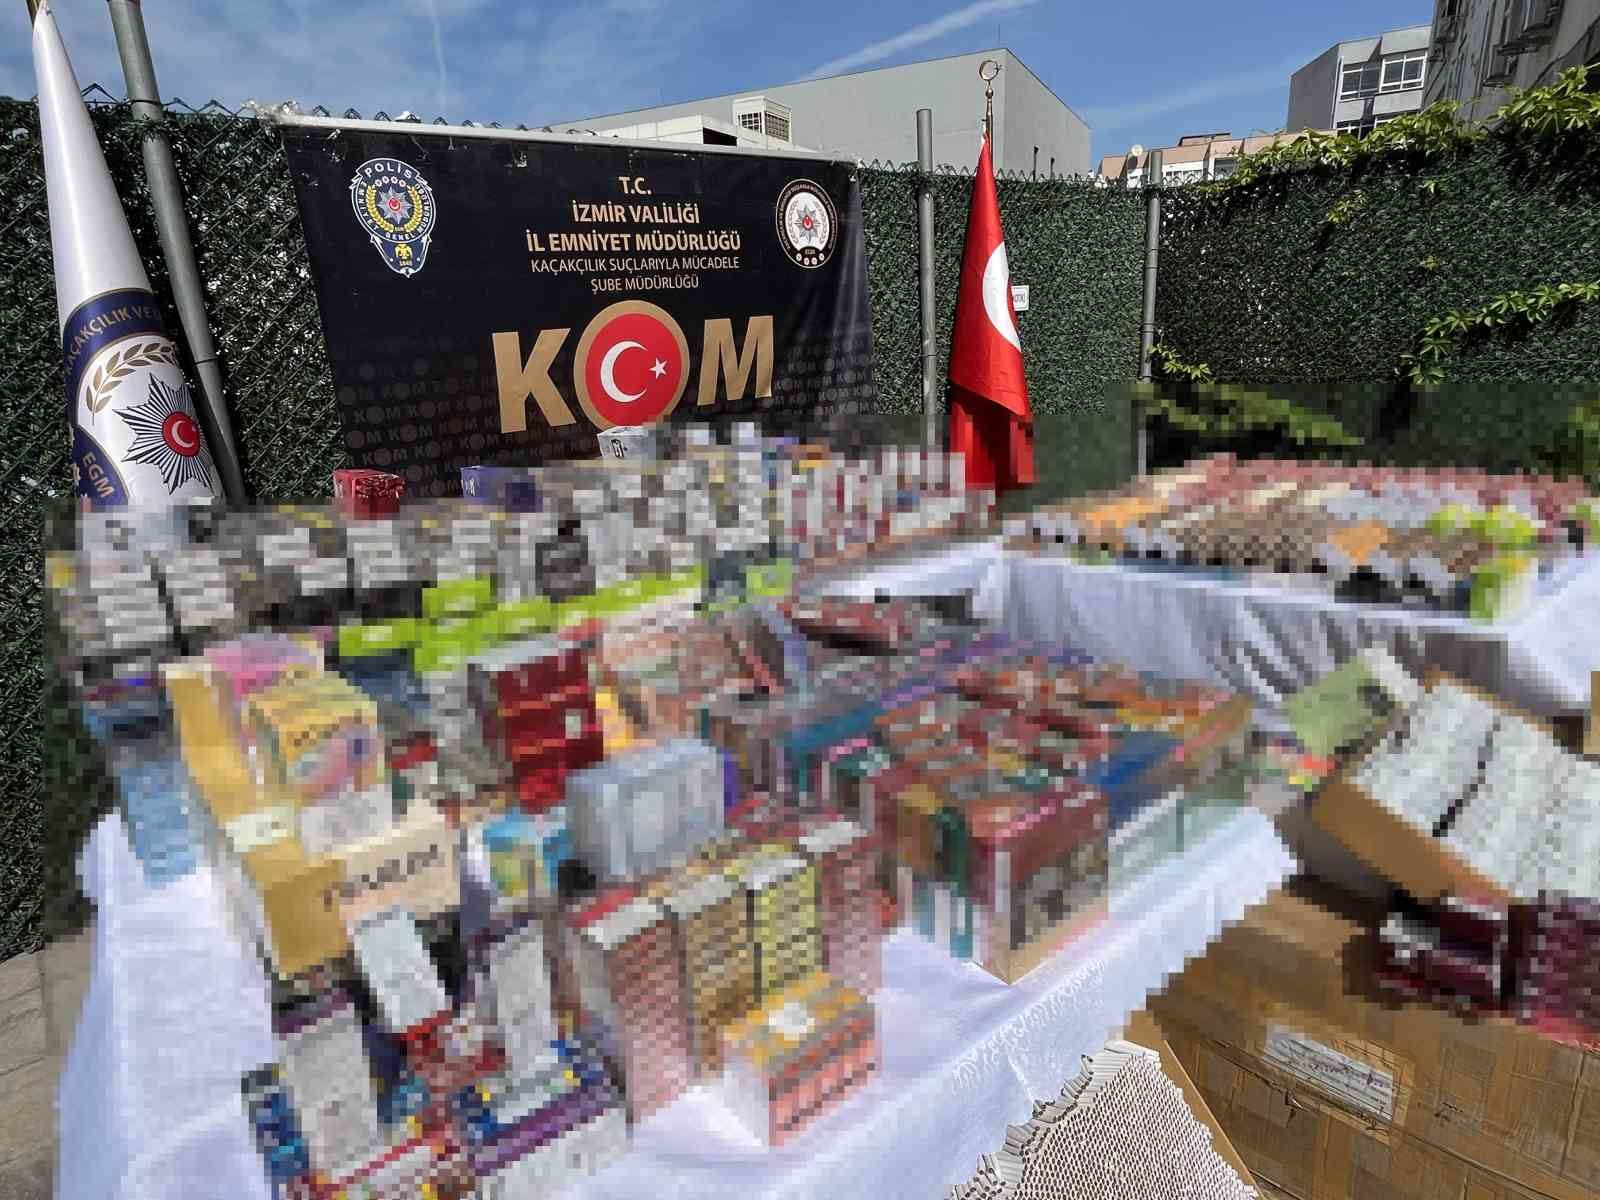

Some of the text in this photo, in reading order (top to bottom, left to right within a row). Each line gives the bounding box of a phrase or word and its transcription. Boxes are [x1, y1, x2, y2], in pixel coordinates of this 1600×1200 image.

[364, 162, 413, 179] POLİS
[618, 176, 652, 195] T.C.
[572, 200, 700, 224] İZMİR VALİLİĞİ
[526, 229, 741, 252] İL EMNİYET MÜDÜRLÜĞÜ
[531, 255, 740, 276] KAÇAKÇILIK SUÇLARIYLA MÜCADELE
[590, 274, 699, 295] ŞUBE MÜDÜRLÜĞÜ
[491, 299, 774, 434] KOM
[83, 452, 114, 498] EGM
